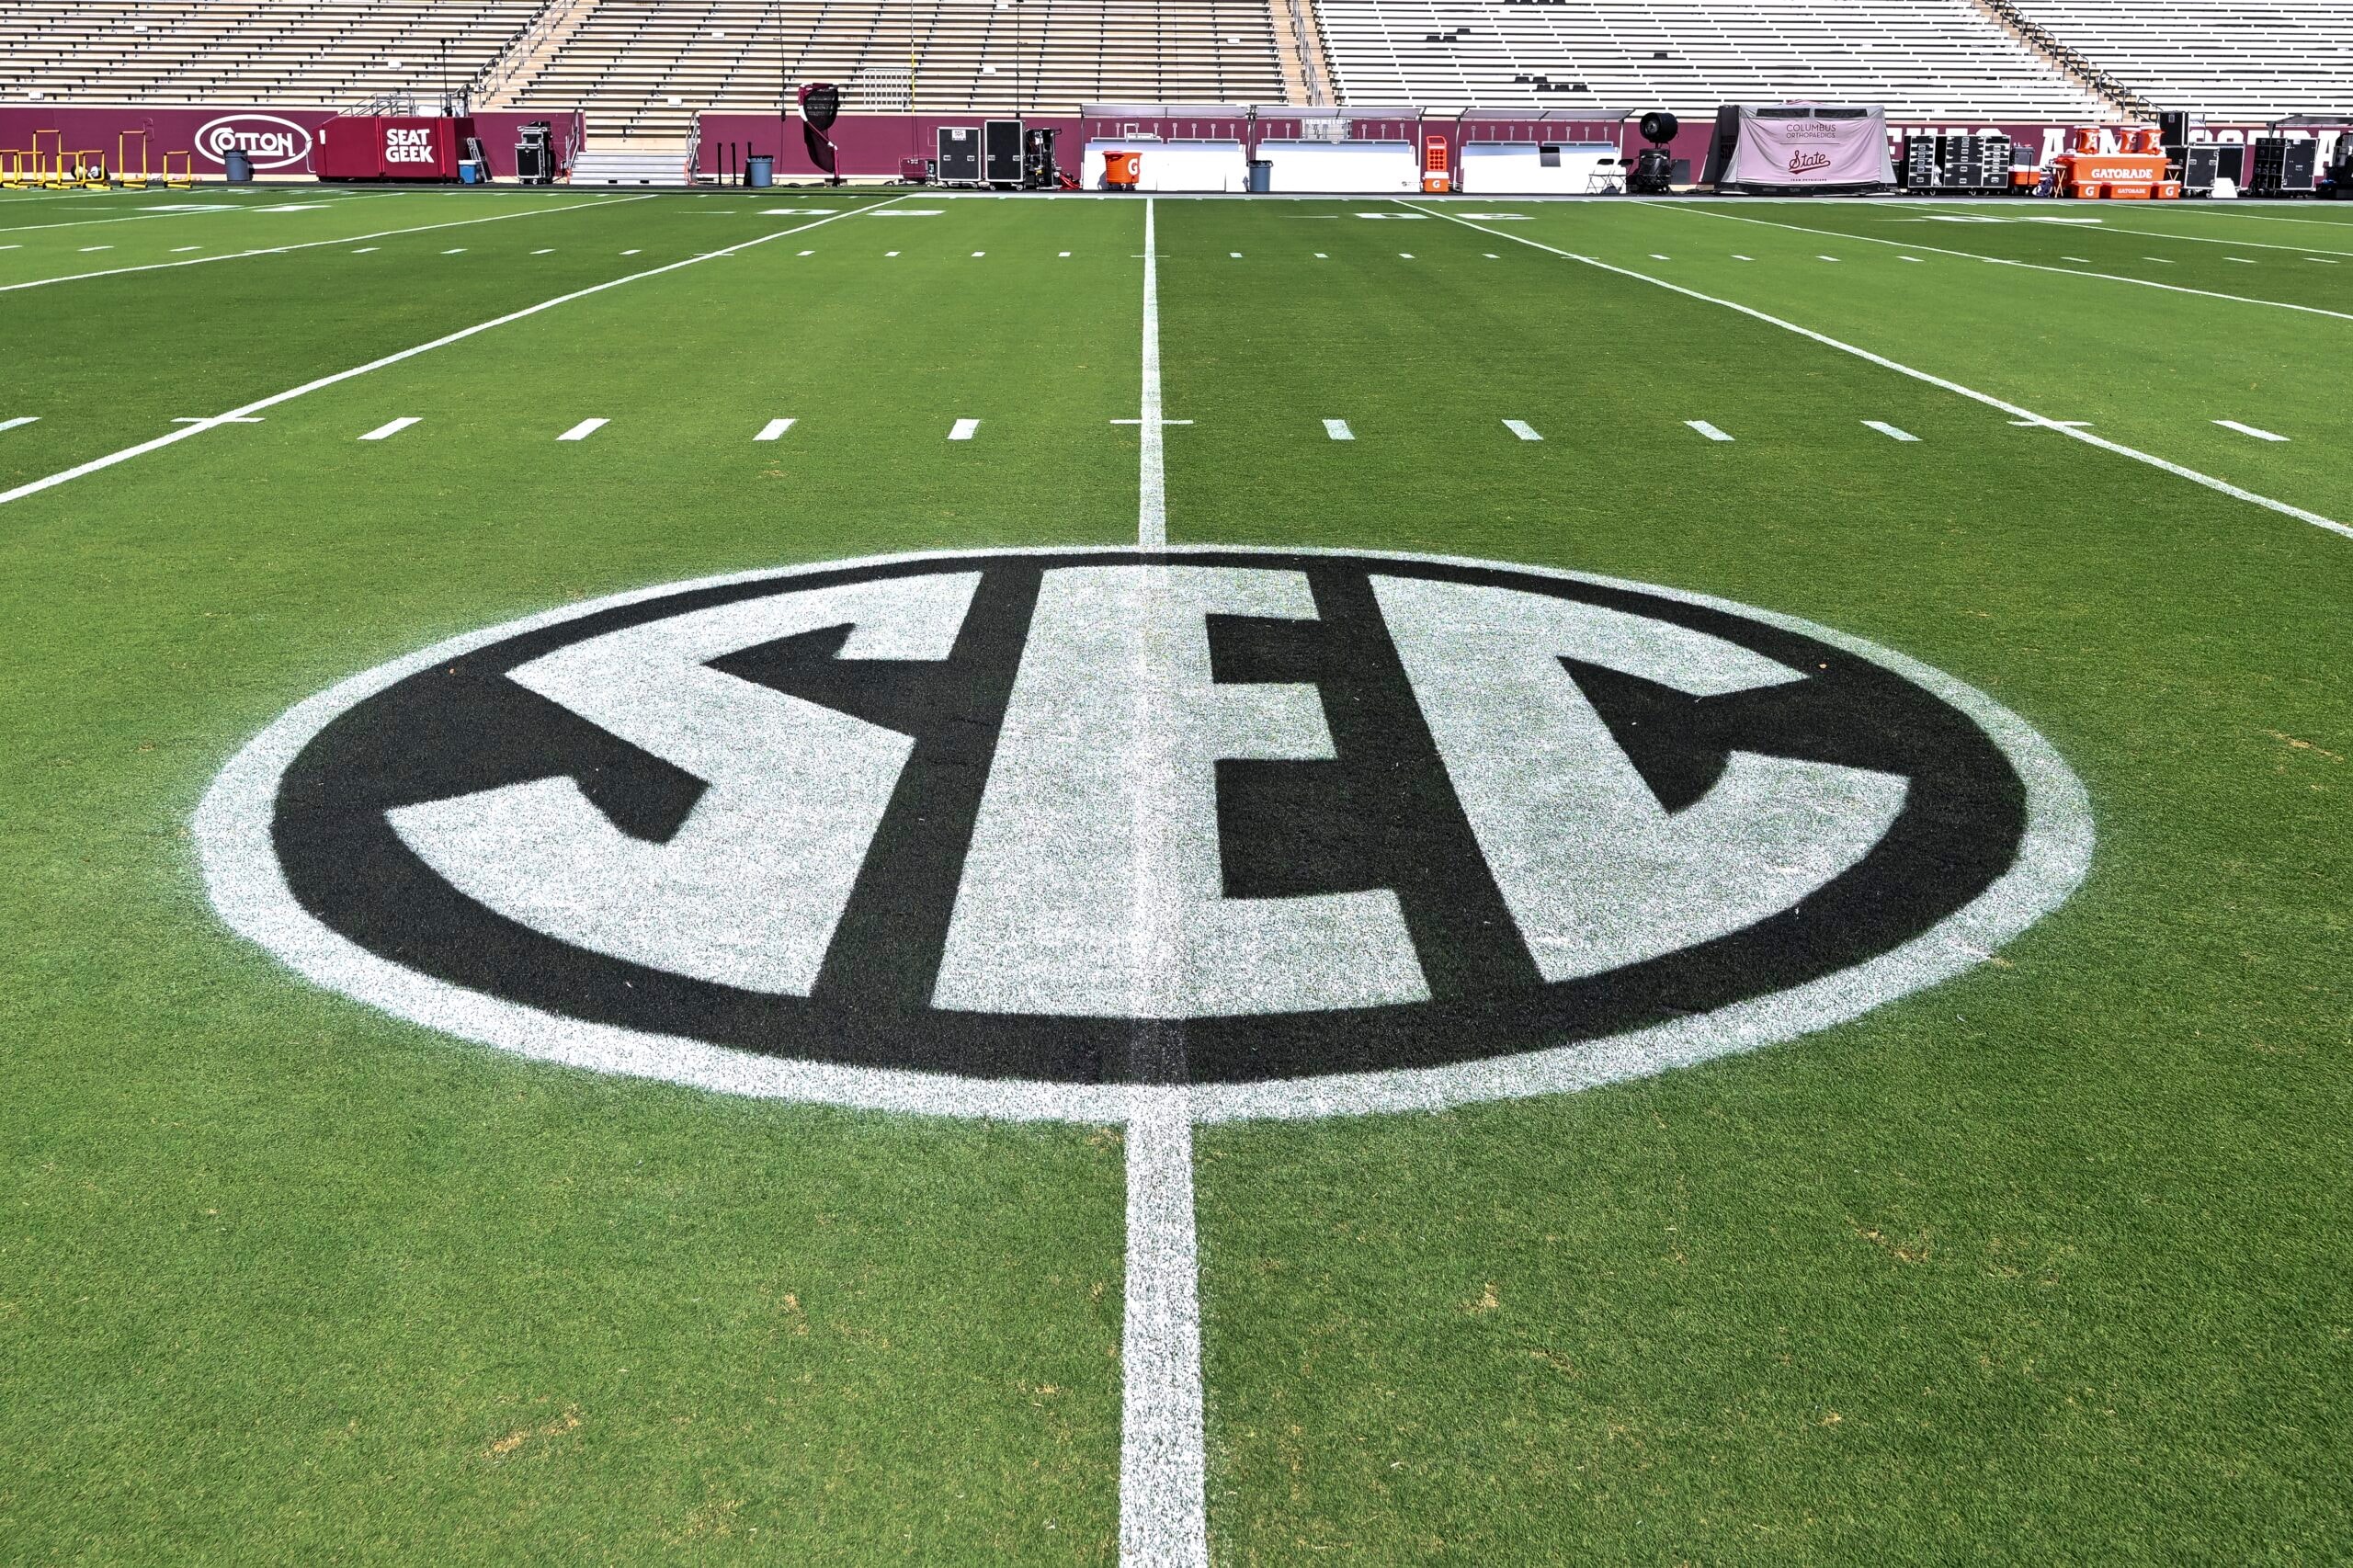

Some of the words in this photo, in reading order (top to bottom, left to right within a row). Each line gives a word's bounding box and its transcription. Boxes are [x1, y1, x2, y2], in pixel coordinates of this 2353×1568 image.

[1786, 123, 1836, 132] COLUMBUS
[210, 127, 296, 157] COTTON
[386, 129, 430, 145] SEAT
[386, 146, 434, 163] GEEK
[1789, 150, 1831, 175] State
[1127, 158, 1139, 175] G
[2091, 168, 2154, 179] GATORADE
[1432, 179, 1440, 189] G
[2085, 187, 2095, 196] G
[2165, 187, 2175, 196] G
[385, 560, 1912, 1018] SEC
